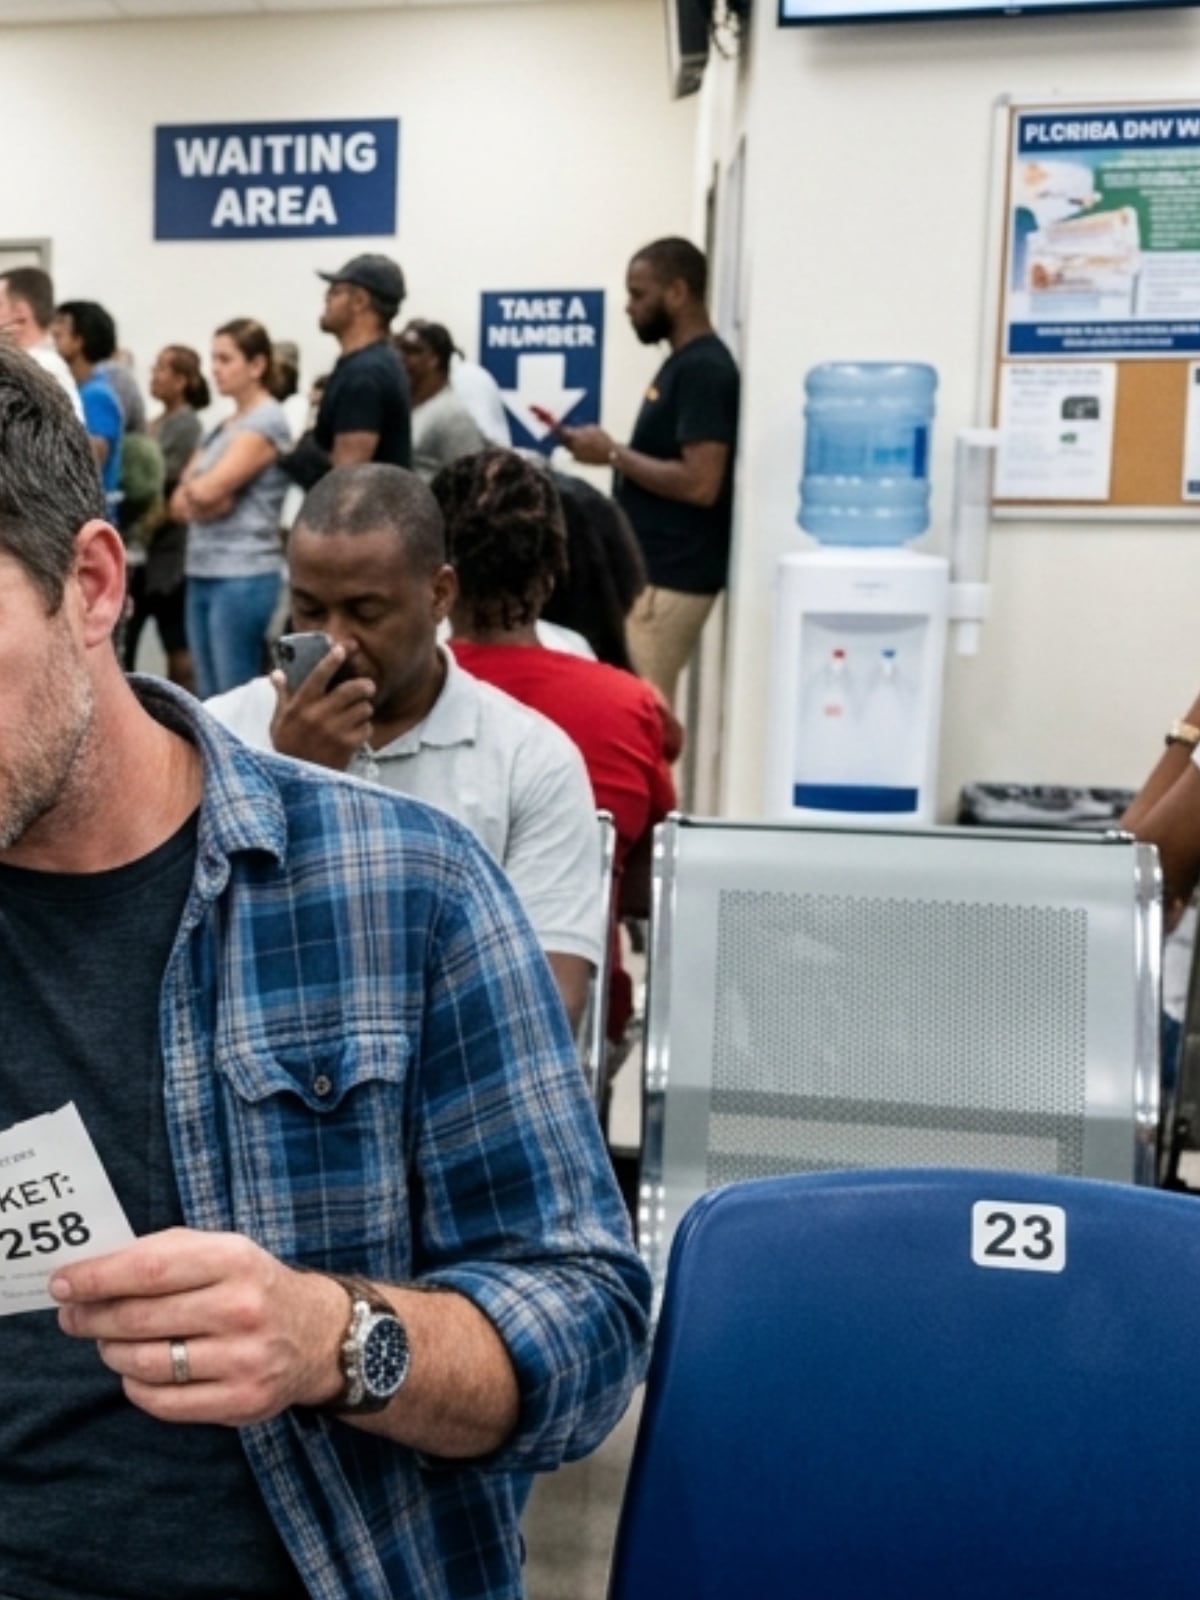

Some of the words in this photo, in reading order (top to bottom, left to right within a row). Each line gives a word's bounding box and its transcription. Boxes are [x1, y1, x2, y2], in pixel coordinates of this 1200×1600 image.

[174, 131, 378, 178] WAITING
[211, 184, 339, 228] AREA
[566, 295, 588, 321] A
[983, 1210, 1055, 1261] 23
